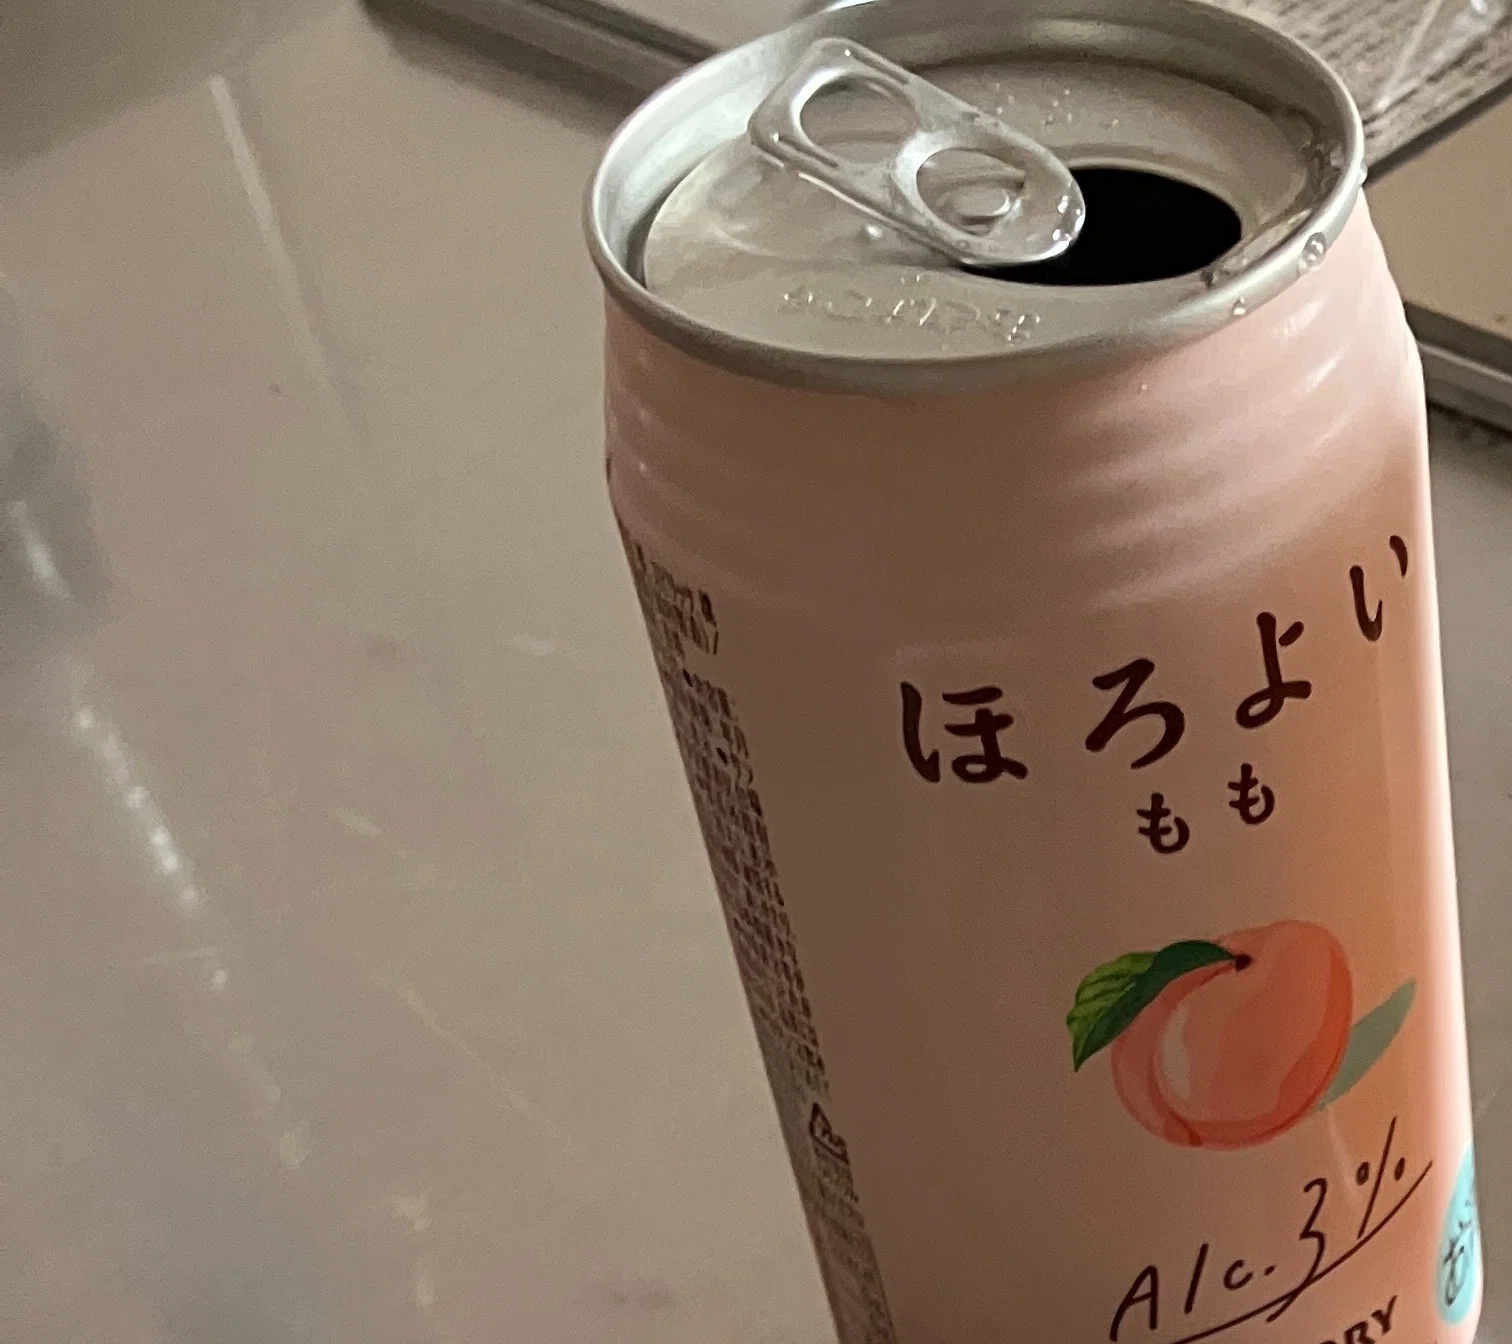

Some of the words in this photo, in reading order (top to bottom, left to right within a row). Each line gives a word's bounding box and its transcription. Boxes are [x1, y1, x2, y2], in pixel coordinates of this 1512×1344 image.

[900, 535, 1409, 784] ほろよい
[1136, 763, 1276, 855] もも
